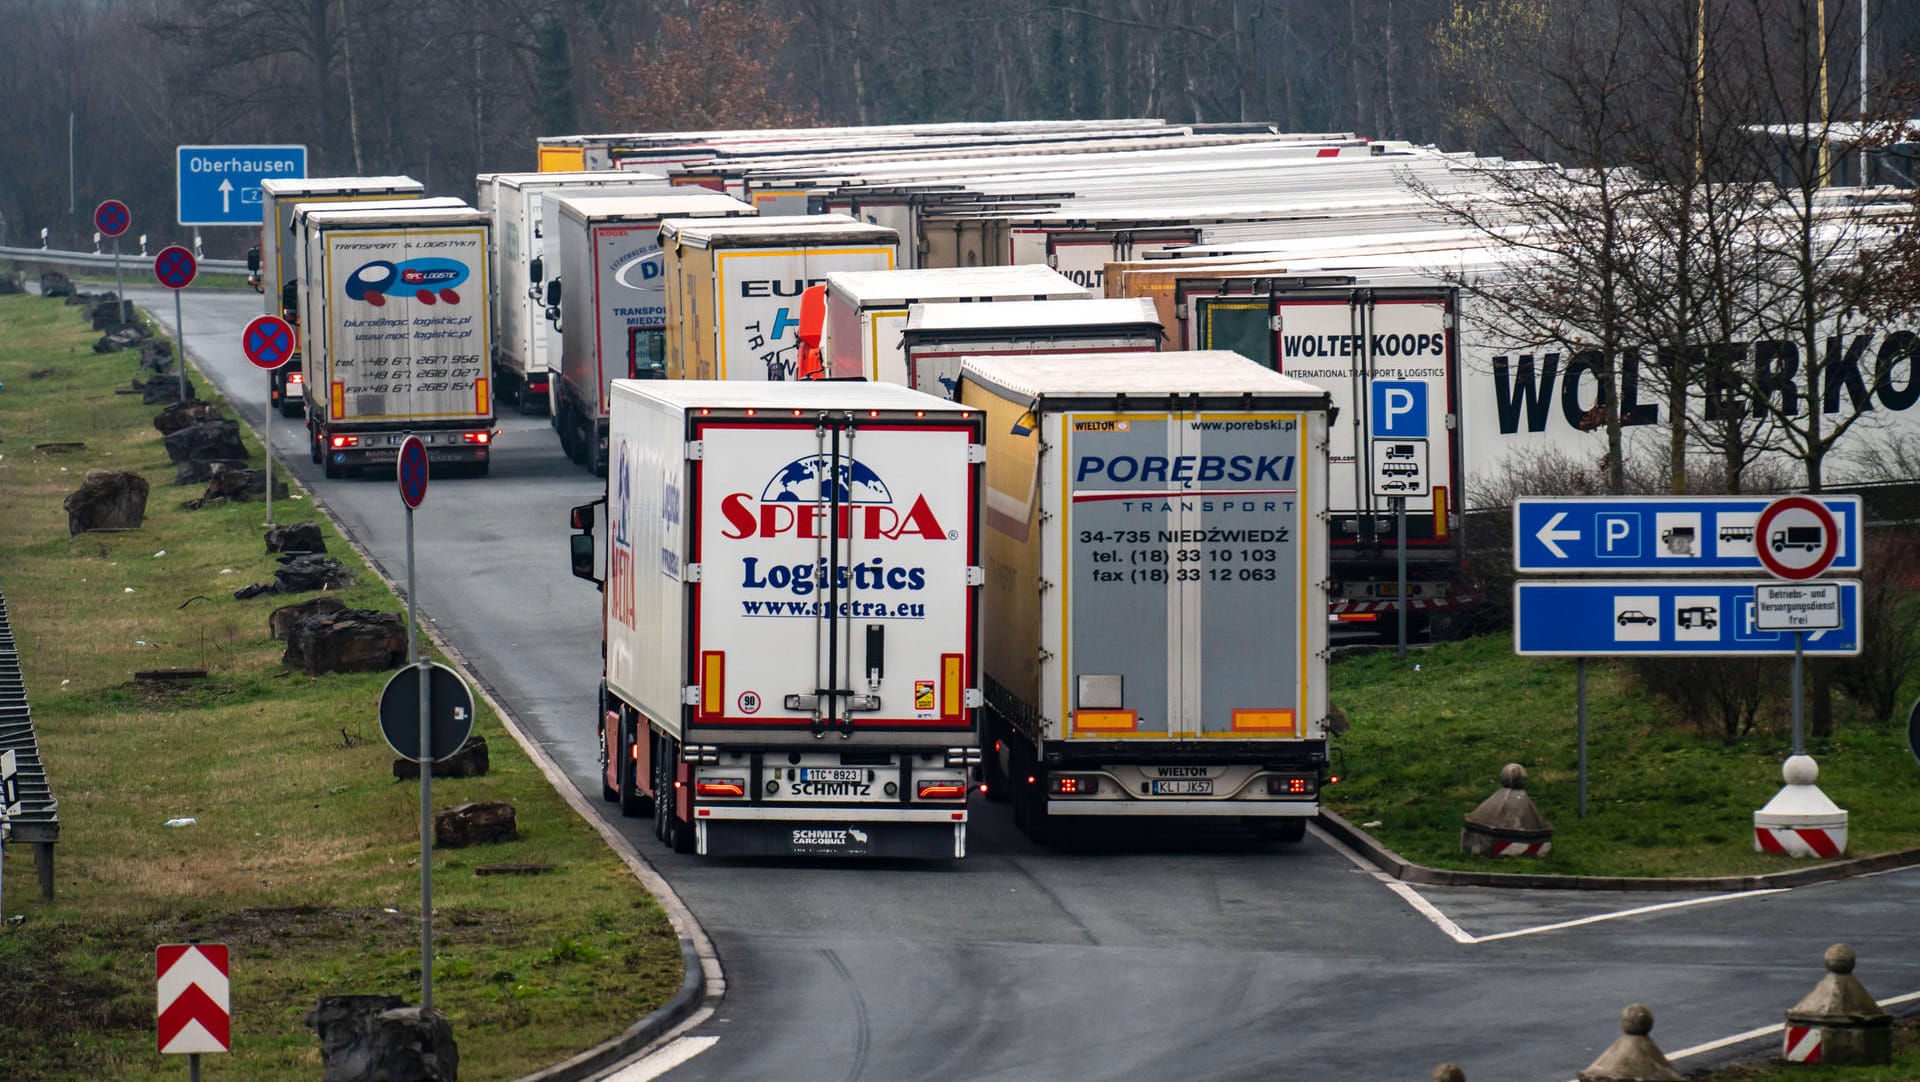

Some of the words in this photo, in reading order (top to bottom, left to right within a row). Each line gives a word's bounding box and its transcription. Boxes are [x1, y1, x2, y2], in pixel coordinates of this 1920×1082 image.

[190, 157, 295, 173] Oberhausen
[251, 190, 258, 200] 2
[416, 240, 476, 248] LOGISTYKA
[424, 271, 457, 279] LOGISTIC
[641, 259, 664, 281] D
[613, 306, 666, 317] TRANSPO
[1371, 333, 1444, 357] KOOPS
[392, 356, 411, 366] 67
[416, 355, 448, 365] 2617
[451, 354, 480, 364] 956
[392, 370, 411, 379] 67
[416, 369, 448, 378] 2618
[451, 368, 481, 378] 027
[1285, 369, 1347, 378] INTERNATIONAL
[1397, 369, 1403, 378] &
[1404, 368, 1445, 377] LOGISTICS
[392, 383, 411, 393] 67
[417, 383, 449, 392] 2619
[451, 382, 475, 391] 154
[1385, 388, 1414, 430] P
[1075, 422, 1115, 431] WIELTON
[1191, 420, 1297, 432] www.porebski.pl
[1076, 456, 1295, 489] PORĘBSKI
[1123, 501, 1295, 513] TRANSPORT
[721, 493, 948, 541] SPETRA
[1080, 530, 1151, 543] 34-735
[1157, 526, 1290, 543] NIEDŹWIEDŹ
[1606, 518, 1630, 552] P
[1092, 550, 1123, 563] tel.
[1131, 550, 1170, 565] (18)
[1176, 550, 1201, 562] 33
[1209, 550, 1233, 562] 10
[1240, 549, 1277, 562] 103
[742, 557, 926, 596] Logistics
[1092, 569, 1124, 582] fax
[1131, 569, 1170, 585] (18)
[1176, 569, 1201, 582] 33
[1208, 569, 1233, 582] 12
[1238, 569, 1277, 582] 063
[1768, 589, 1807, 599] Betriebs-
[1810, 589, 1826, 598] und
[742, 599, 926, 620] www.spetra.eu
[1760, 602, 1835, 613] Versorgungsdienst
[1788, 615, 1808, 624] frei
[744, 695, 756, 706] 90
[809, 769, 827, 780] 1TC
[833, 769, 857, 780] 8923
[1158, 766, 1208, 777] WIELTON
[791, 783, 871, 796] SCHMITZ
[1186, 781, 1210, 793] JK57
[792, 830, 847, 839] SCHMITZ
